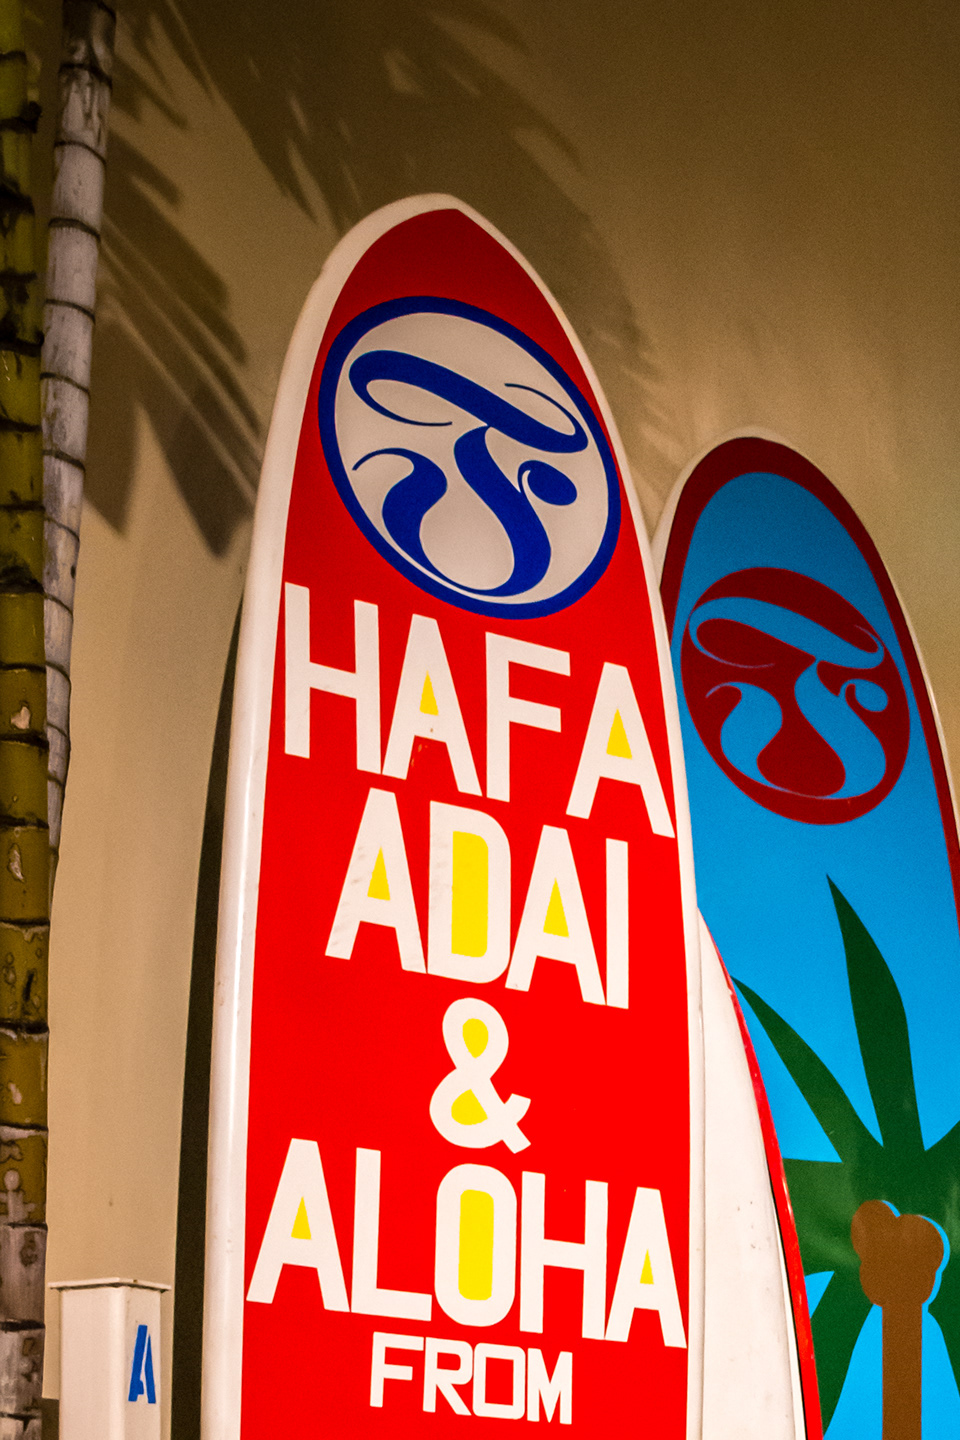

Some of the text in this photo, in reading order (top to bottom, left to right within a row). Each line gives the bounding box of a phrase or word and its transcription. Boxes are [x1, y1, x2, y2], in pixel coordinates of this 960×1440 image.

[285, 582, 675, 838] HAFA
[325, 787, 629, 1009] ADAI
[429, 997, 531, 1154] &
[246, 1138, 688, 1349] ALOHA
[369, 1332, 573, 1425] FROM
